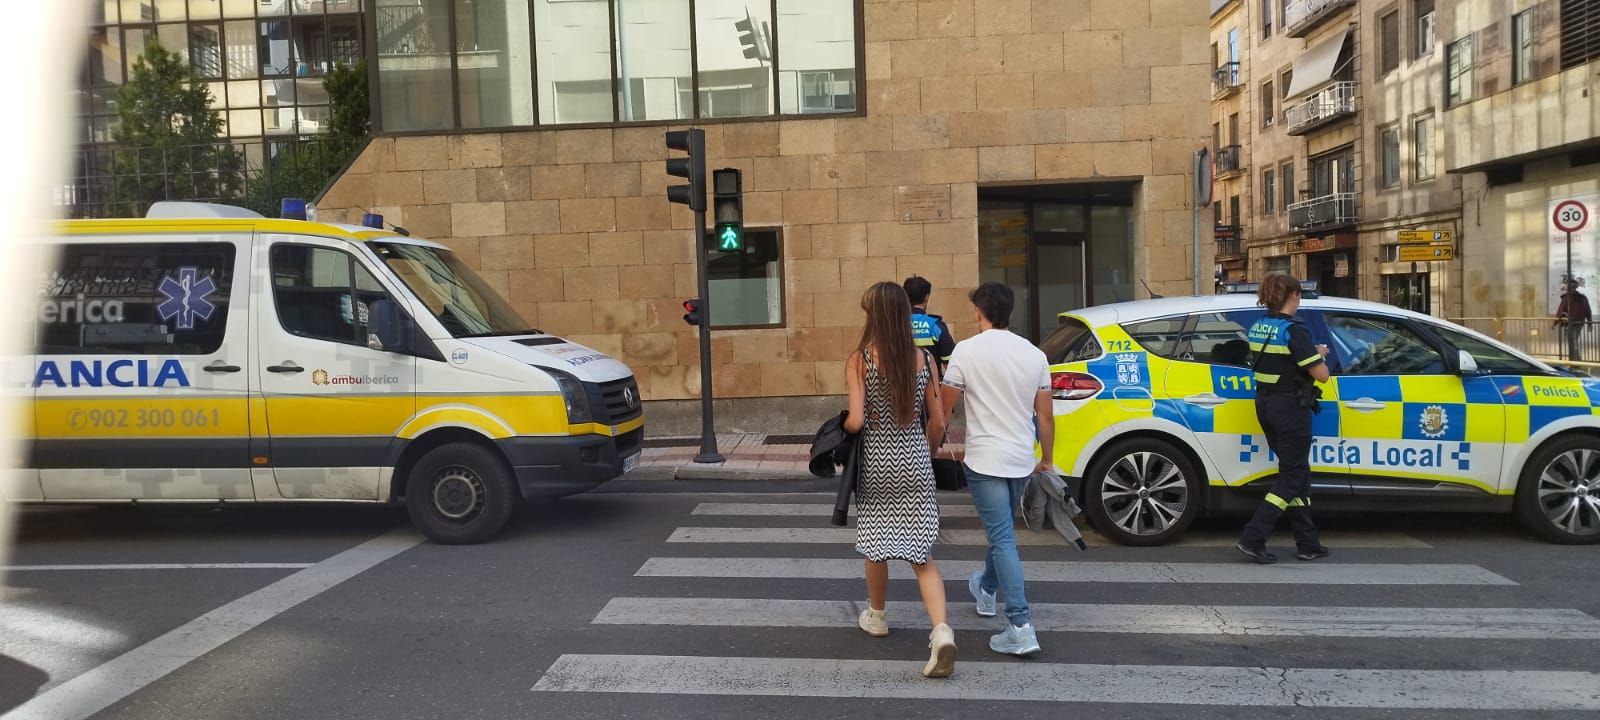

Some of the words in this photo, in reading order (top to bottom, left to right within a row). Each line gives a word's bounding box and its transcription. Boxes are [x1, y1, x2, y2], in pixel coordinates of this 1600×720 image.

[1562, 211, 1581, 222] 30
[912, 320, 930, 329] CIA
[1107, 340, 1131, 351] 712
[1227, 375, 1256, 390] 11
[1532, 384, 1579, 398] Policía
[89, 408, 128, 428] 902
[136, 408, 175, 428] 300
[181, 408, 220, 428] 061
[1373, 440, 1442, 468] Local
